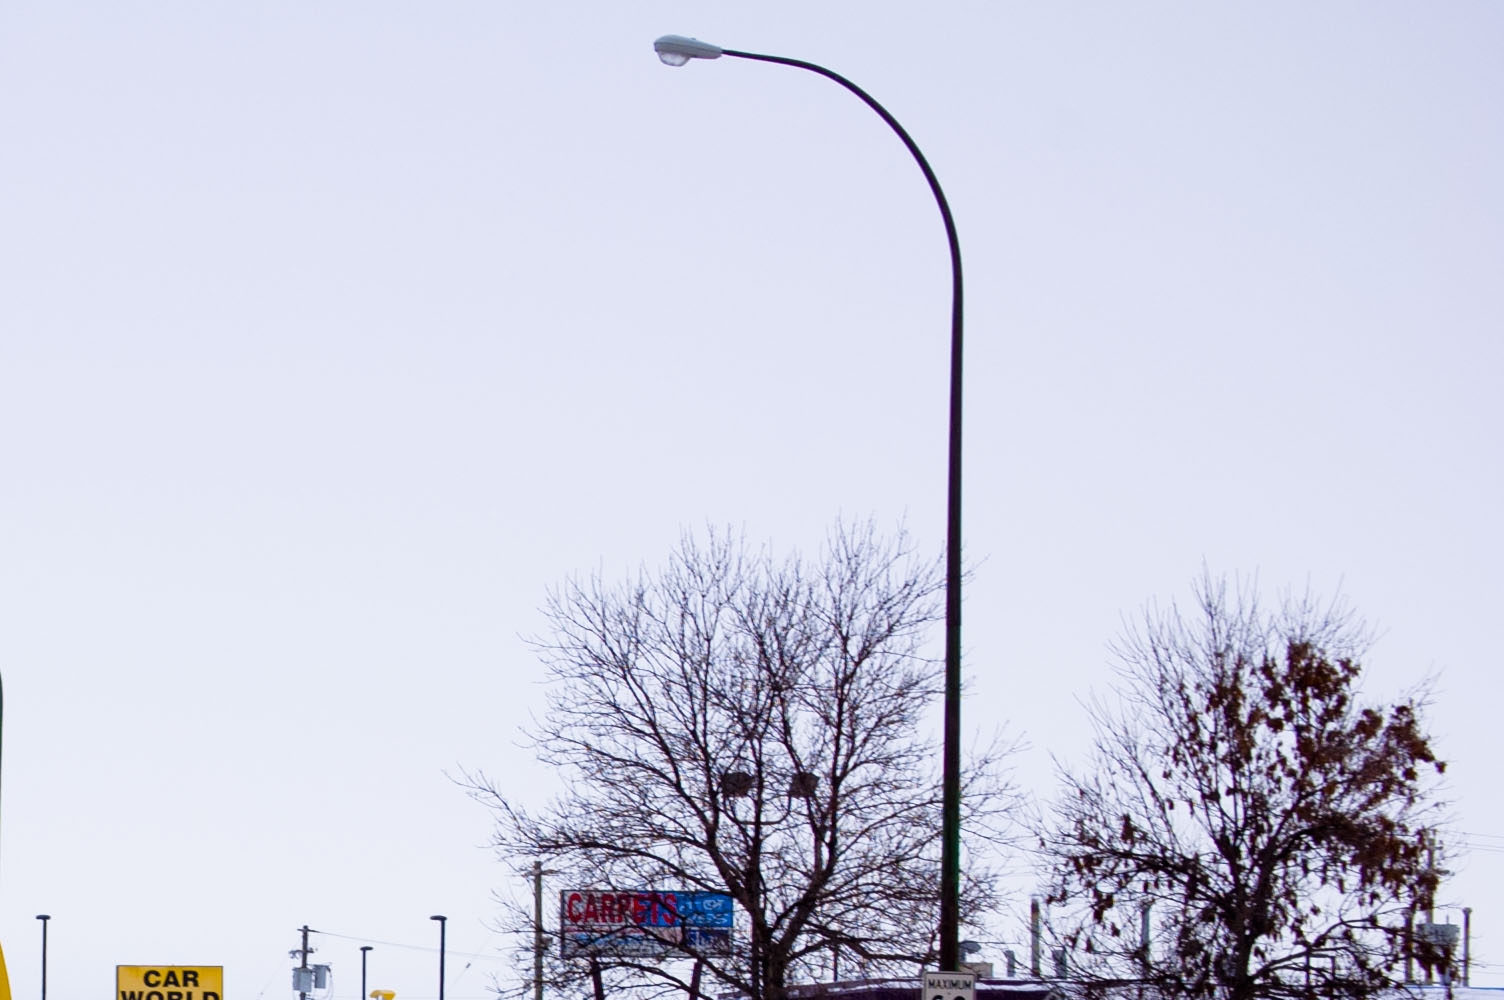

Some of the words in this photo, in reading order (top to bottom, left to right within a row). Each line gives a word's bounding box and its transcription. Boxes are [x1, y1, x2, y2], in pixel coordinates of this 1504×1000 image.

[568, 893, 677, 925] CARPETS
[143, 970, 199, 987] CAR
[928, 979, 972, 989] MAXIMUM
